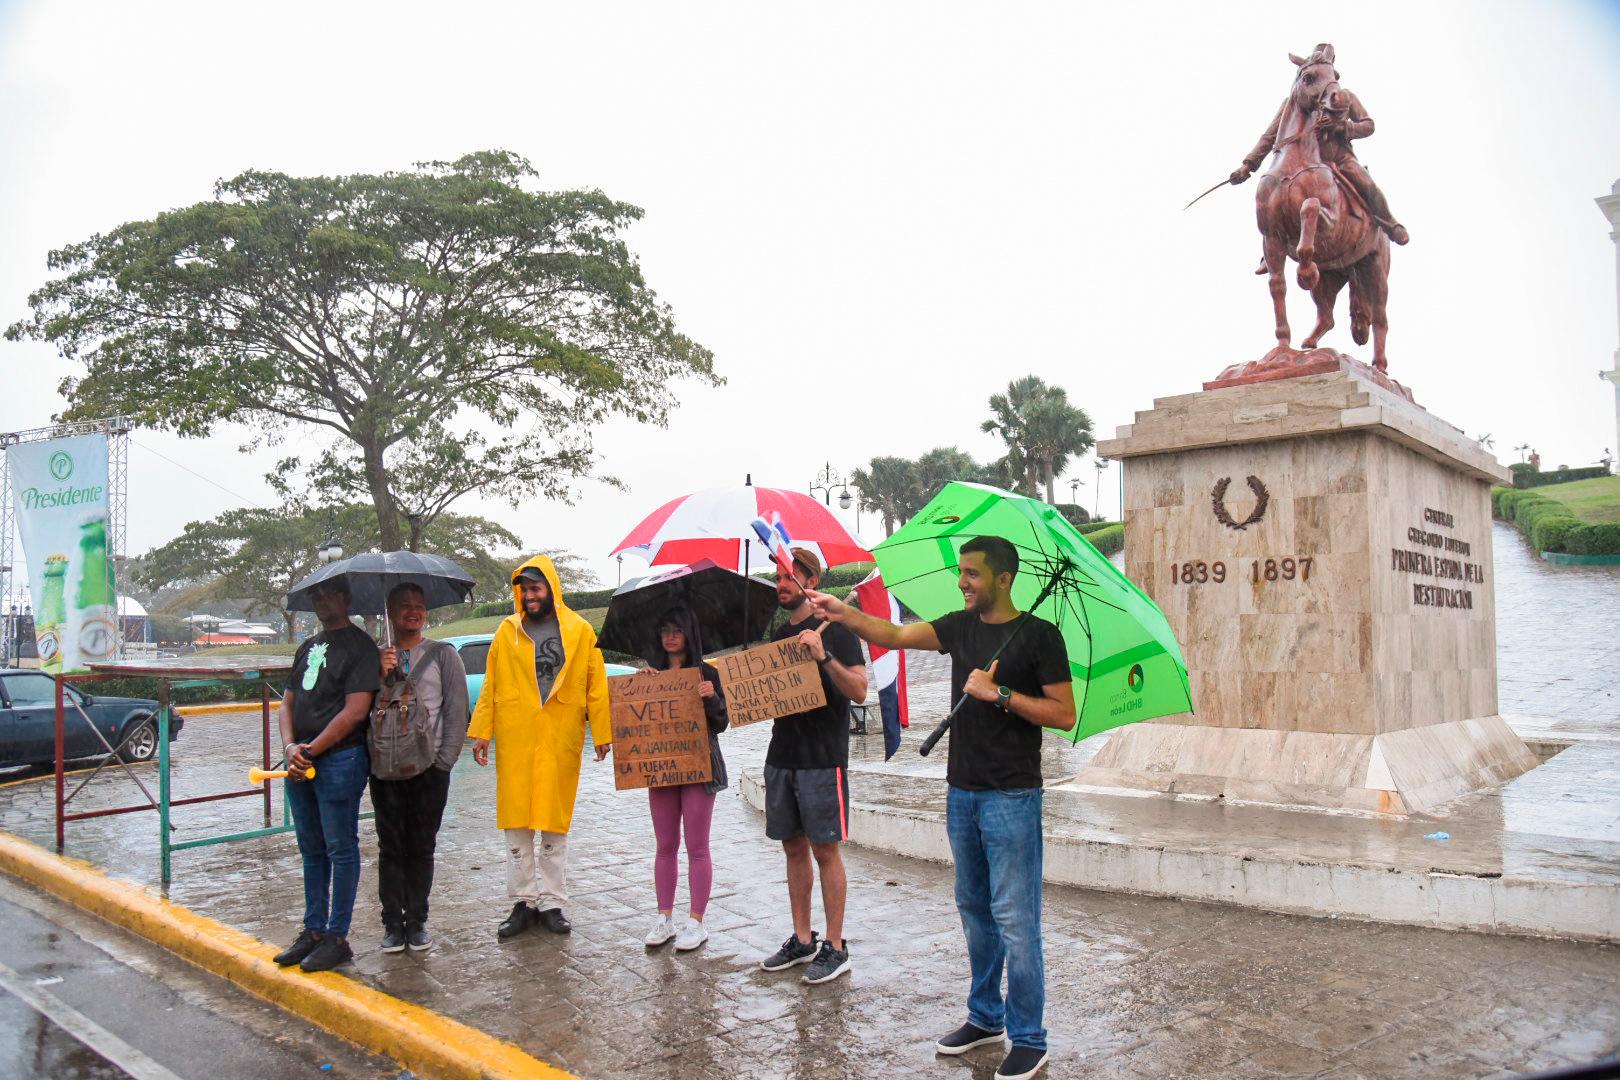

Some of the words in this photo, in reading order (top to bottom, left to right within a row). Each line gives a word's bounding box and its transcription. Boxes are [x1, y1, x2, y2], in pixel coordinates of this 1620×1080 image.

[20, 486, 103, 510] Presidente
[1424, 507, 1455, 529] GENERAL
[1408, 526, 1443, 549] GREGORIO
[1170, 561, 1226, 585] 1839
[1251, 556, 1313, 583] 1897
[1392, 548, 1433, 577] PRIMERA
[1434, 556, 1463, 581] ESPADA
[1464, 562, 1474, 583] DE
[1474, 564, 1484, 584] LA
[1413, 583, 1473, 610] RESTAURACION
[743, 650, 766, 676] 15
[726, 673, 787, 701] VOTEMOS
[787, 670, 803, 688] EN
[629, 699, 681, 721] VETE
[729, 698, 760, 711] CONTRA
[763, 692, 780, 704] DEL
[731, 706, 773, 725] CANCER
[773, 692, 820, 716] POLITICO
[657, 722, 670, 735] TE
[673, 720, 700, 735] ESTA
[620, 762, 633, 775] LA
[638, 759, 677, 774] PUERTA
[644, 774, 659, 787] TA
